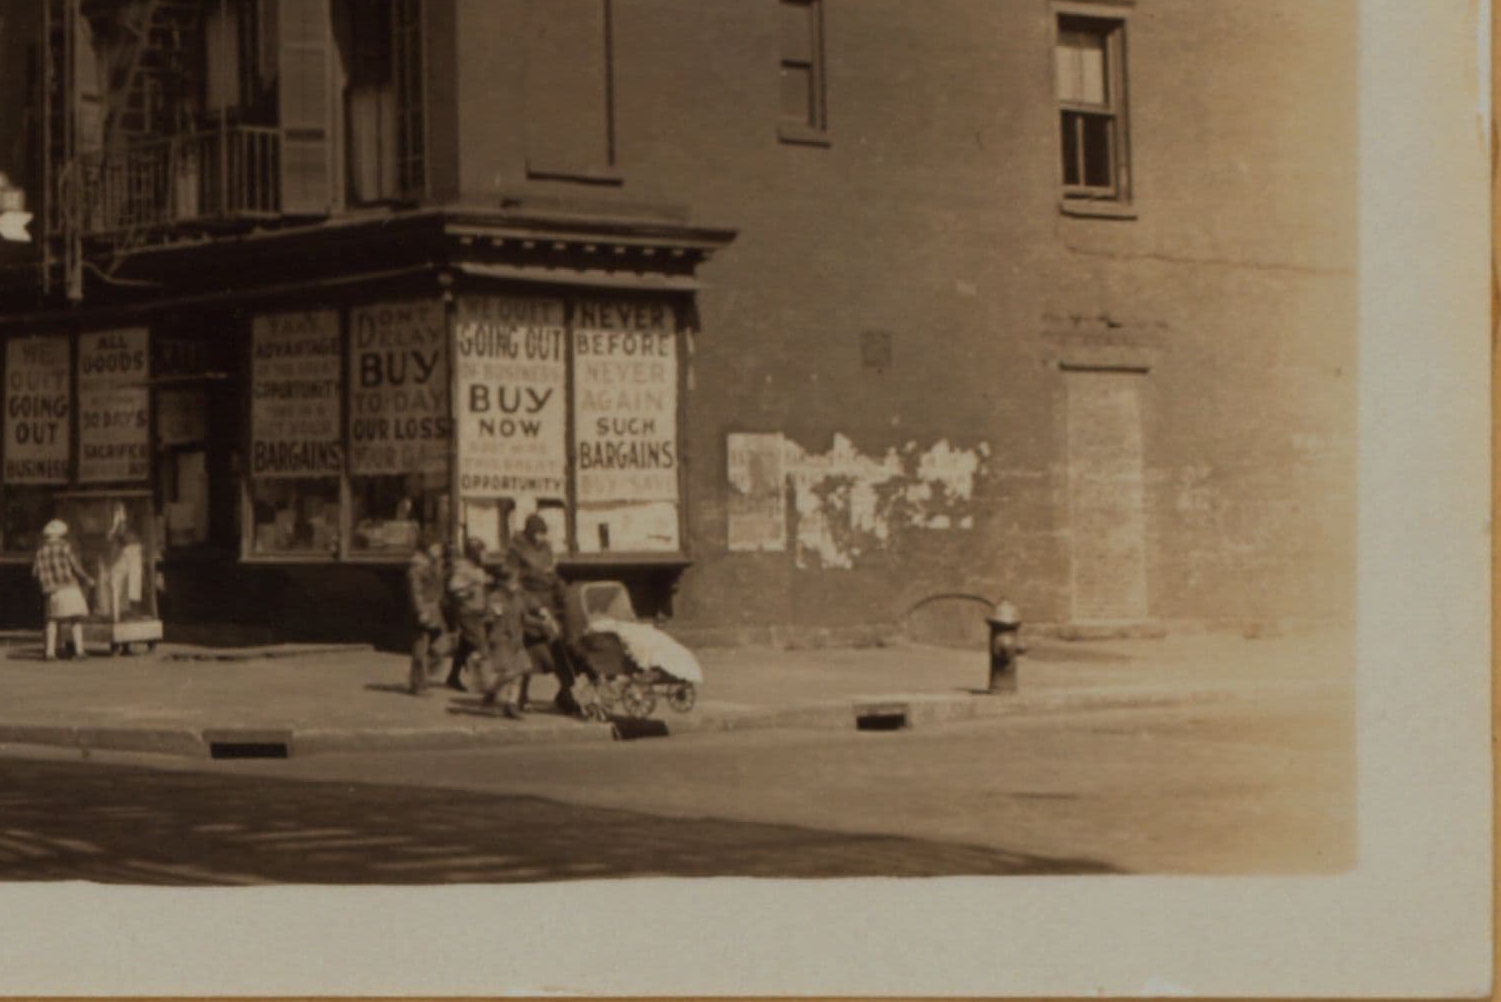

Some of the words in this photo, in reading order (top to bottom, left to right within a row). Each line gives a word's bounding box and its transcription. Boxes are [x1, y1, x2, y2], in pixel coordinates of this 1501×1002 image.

[582, 304, 664, 330] NEVER
[460, 324, 519, 361] GOING
[525, 328, 561, 363] OUT
[577, 332, 669, 358] BEFORE
[361, 350, 439, 388] BUY
[587, 361, 665, 384] NEVER
[9, 395, 68, 419] GOING
[468, 383, 554, 415] BUY
[580, 388, 664, 411] AGAIN
[16, 422, 58, 444] OUT
[354, 418, 389, 441] OUR
[478, 418, 542, 438] NOW
[595, 416, 656, 437] SUCH
[254, 440, 341, 472] BARGAINS
[579, 440, 674, 471] BARGAINS
[461, 474, 562, 492] OPPORTUNITY
